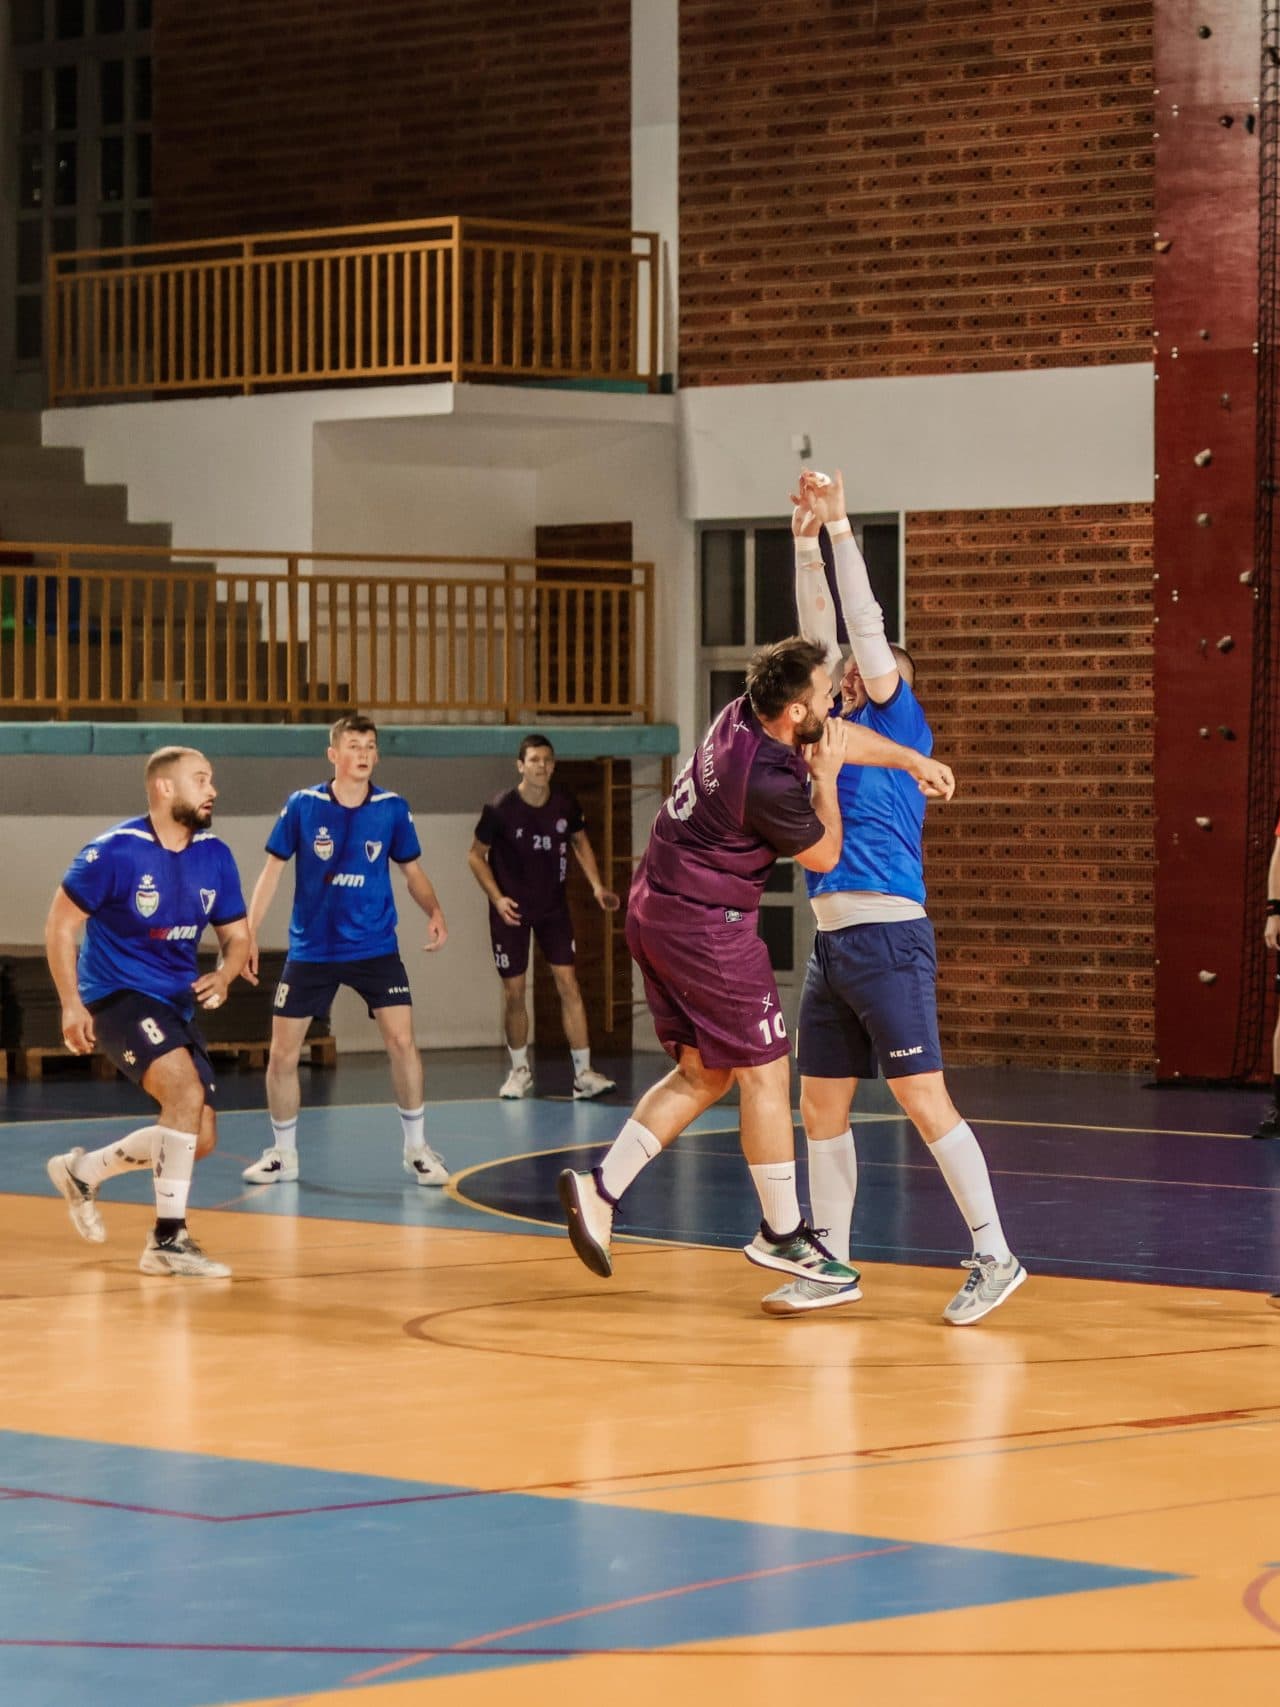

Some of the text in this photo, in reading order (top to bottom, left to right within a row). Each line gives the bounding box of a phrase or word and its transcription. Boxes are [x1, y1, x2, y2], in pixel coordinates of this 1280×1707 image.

[533, 834, 552, 850] 28
[141, 1017, 165, 1045] 8
[758, 1011, 787, 1046] 10
[890, 1045, 923, 1058] KELME
